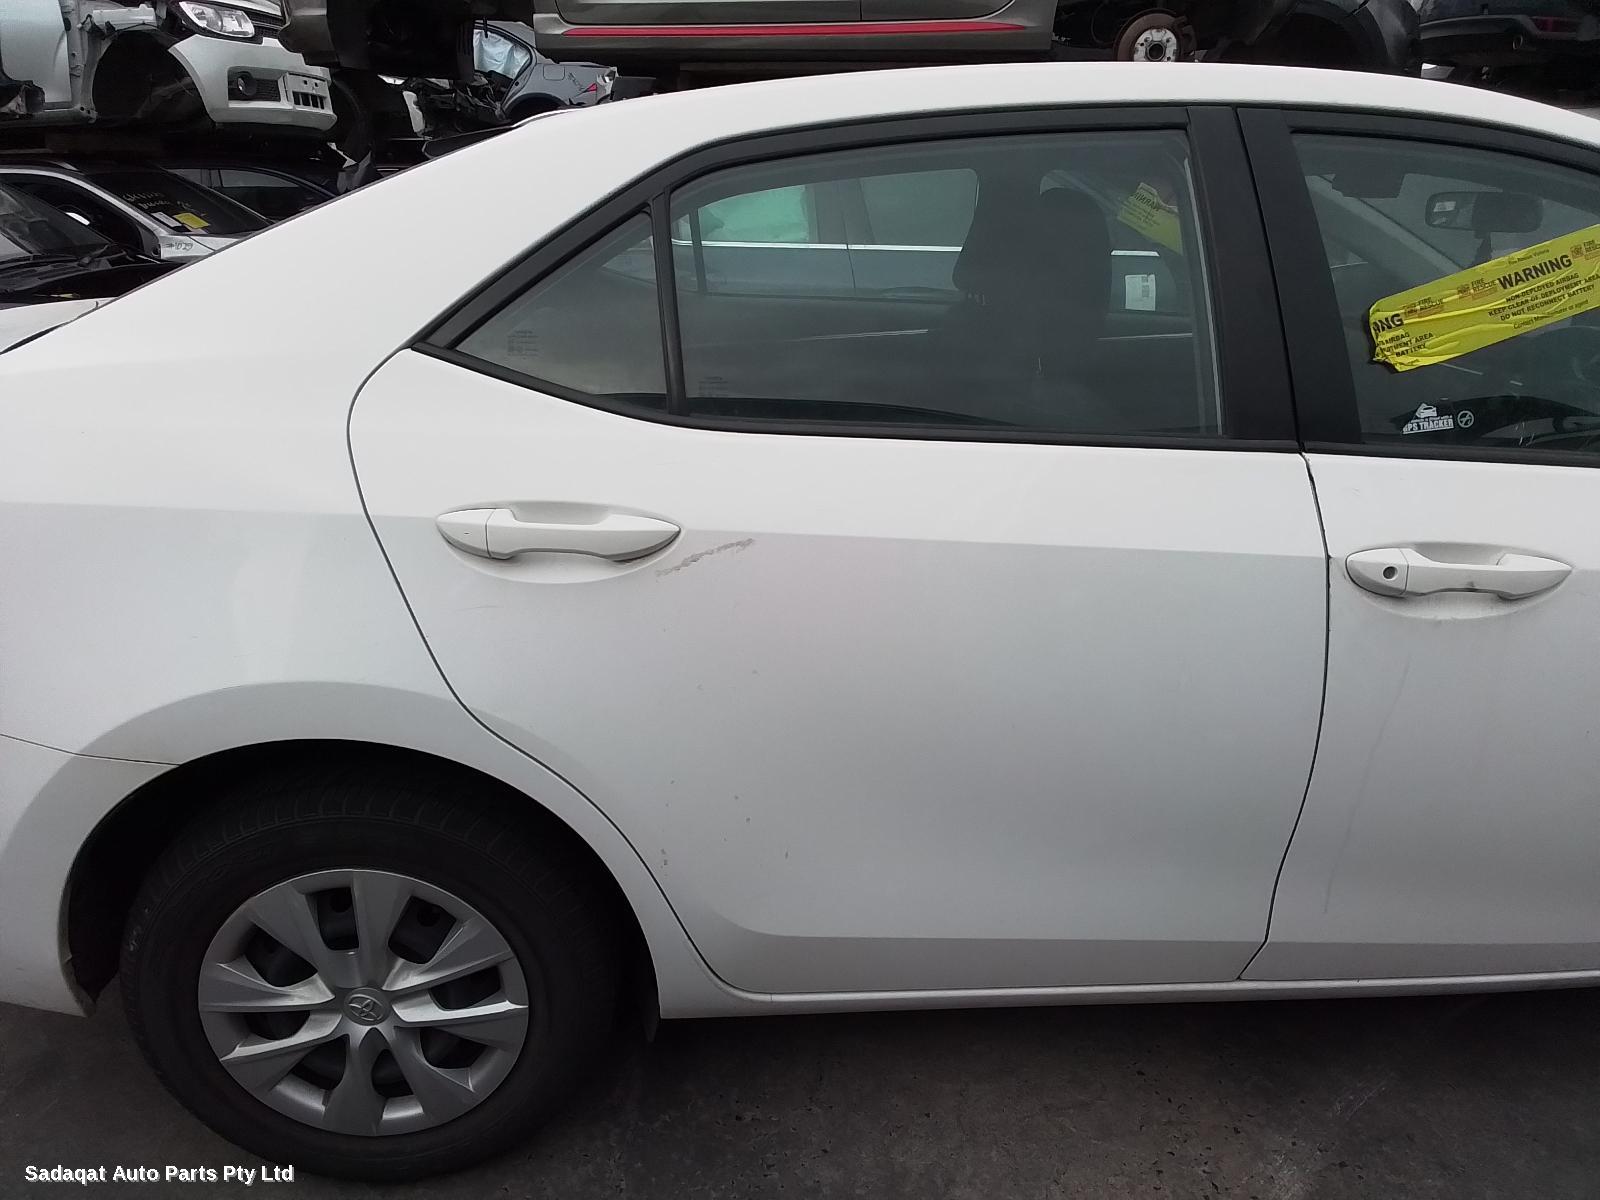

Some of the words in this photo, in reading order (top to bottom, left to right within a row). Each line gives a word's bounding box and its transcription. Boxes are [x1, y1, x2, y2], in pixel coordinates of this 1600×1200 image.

[1497, 254, 1573, 290] WARNING
[1506, 281, 1555, 302] NON-DEPLOYED
[1556, 272, 1580, 286] AIRBAG
[1488, 306, 1507, 317] KEEP
[1508, 298, 1529, 310] CLEAR
[1540, 280, 1582, 299] DEPLOYMENT
[1500, 313, 1511, 321] DO
[1511, 307, 1526, 317] NOT
[1526, 293, 1566, 312] RECONNECT
[1566, 284, 1595, 298] BATTERY
[1415, 333, 1434, 343] AREA
[1419, 418, 1453, 430] TRACKER
